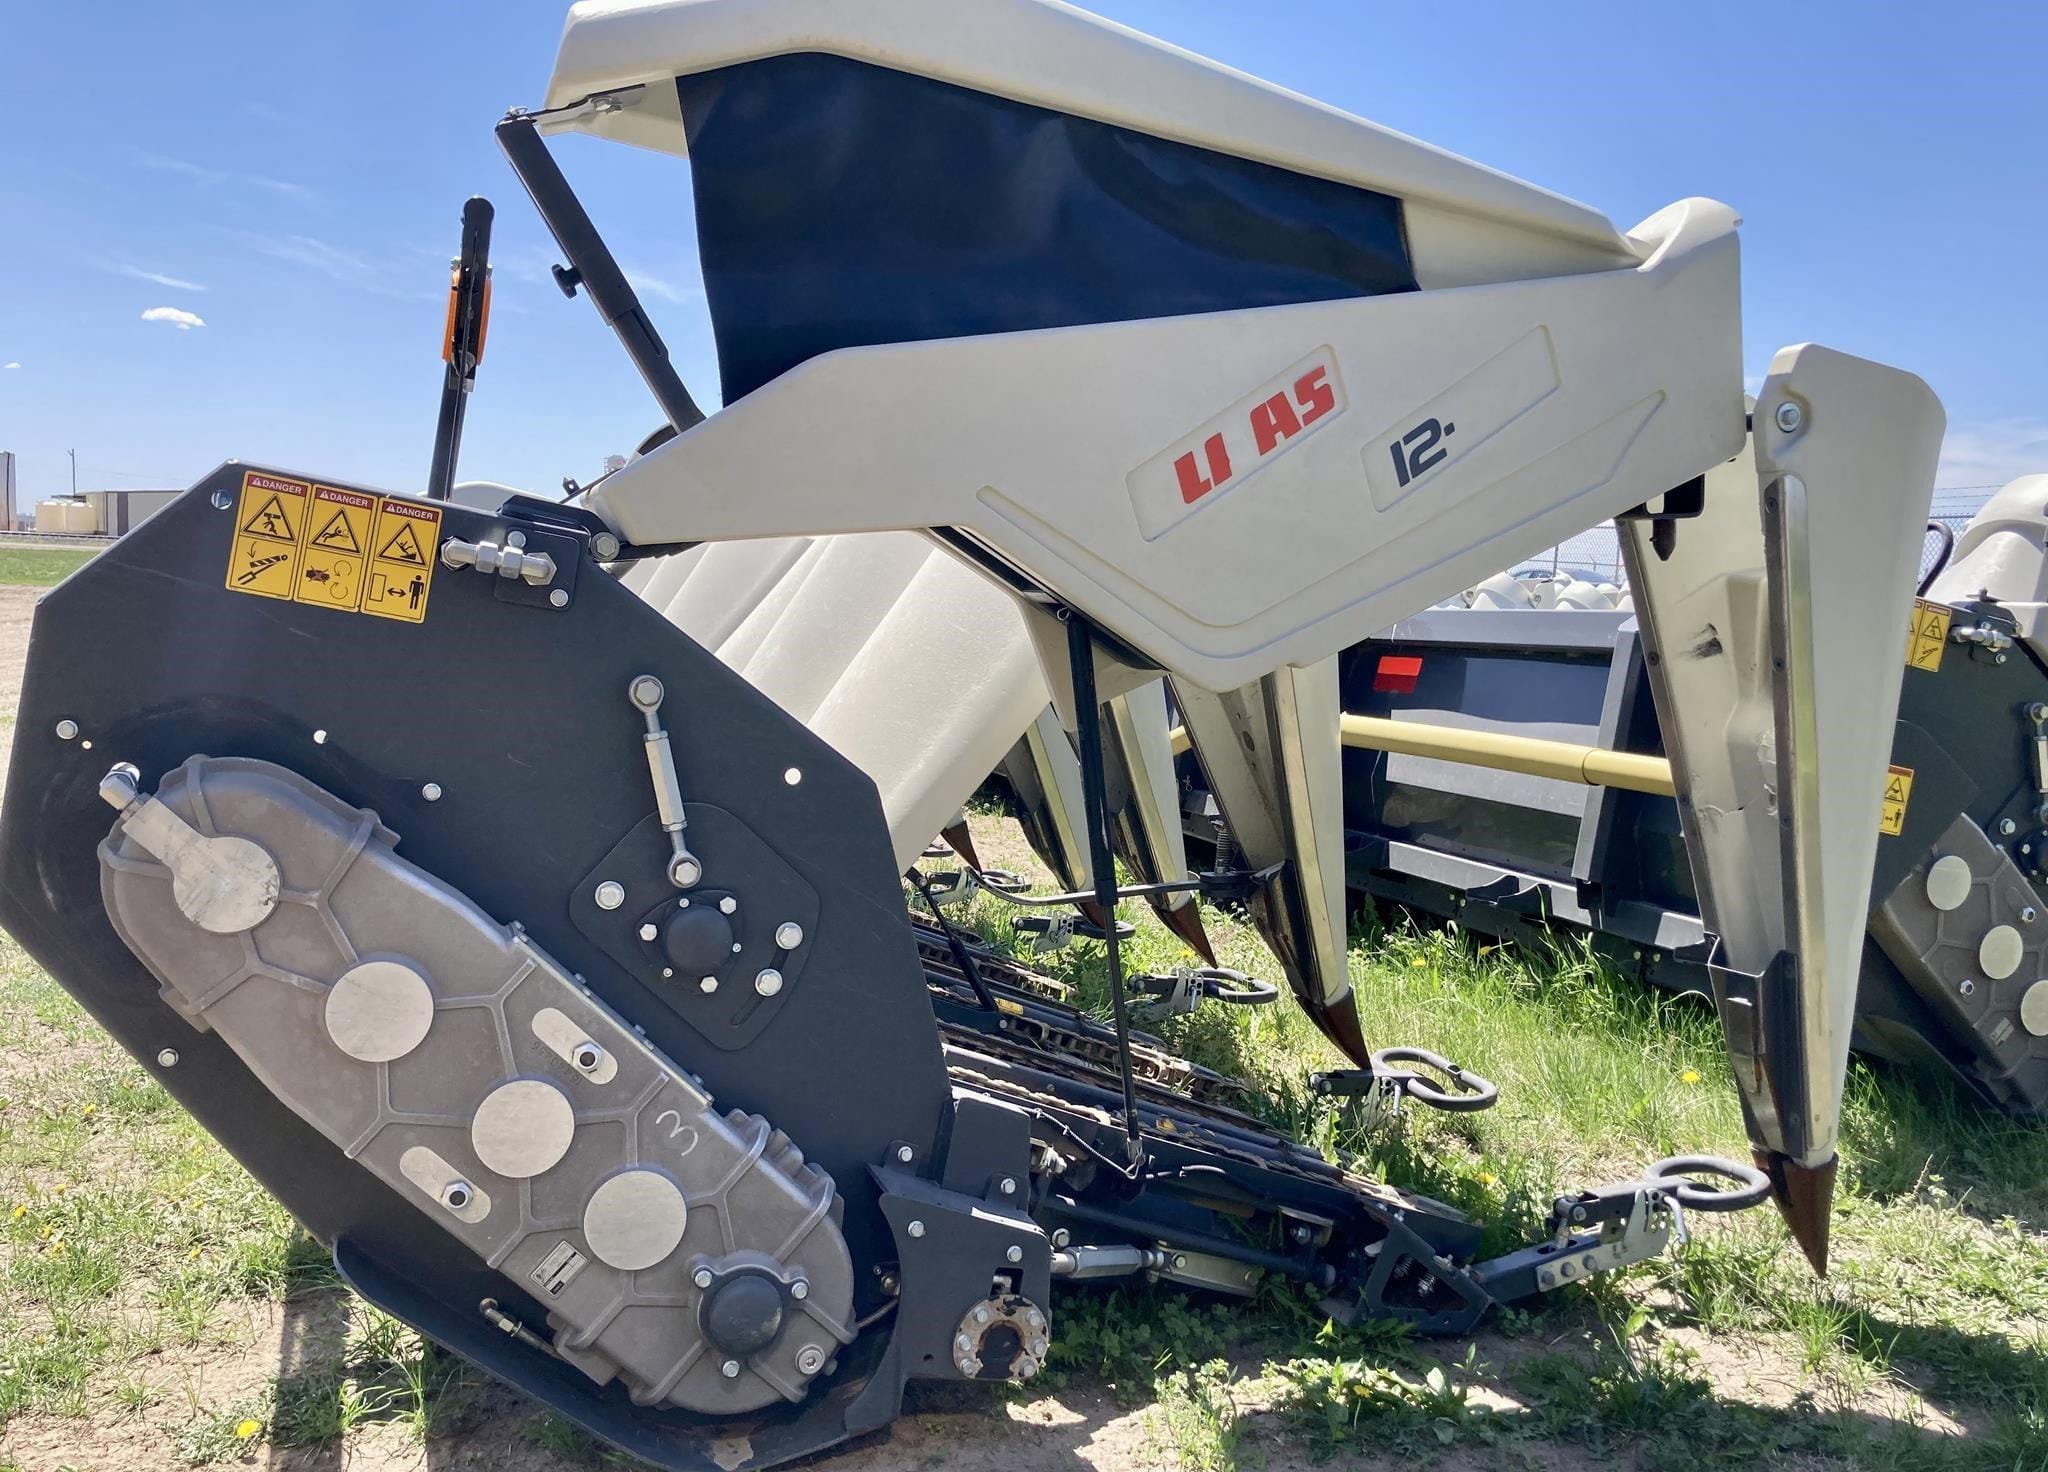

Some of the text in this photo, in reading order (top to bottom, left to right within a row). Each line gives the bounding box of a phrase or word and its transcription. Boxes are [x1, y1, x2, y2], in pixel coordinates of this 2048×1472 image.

[262, 480, 302, 494] DANGER
[329, 493, 368, 507] DANGER
[396, 506, 434, 521] DANGER
[656, 1110, 698, 1156] 3
